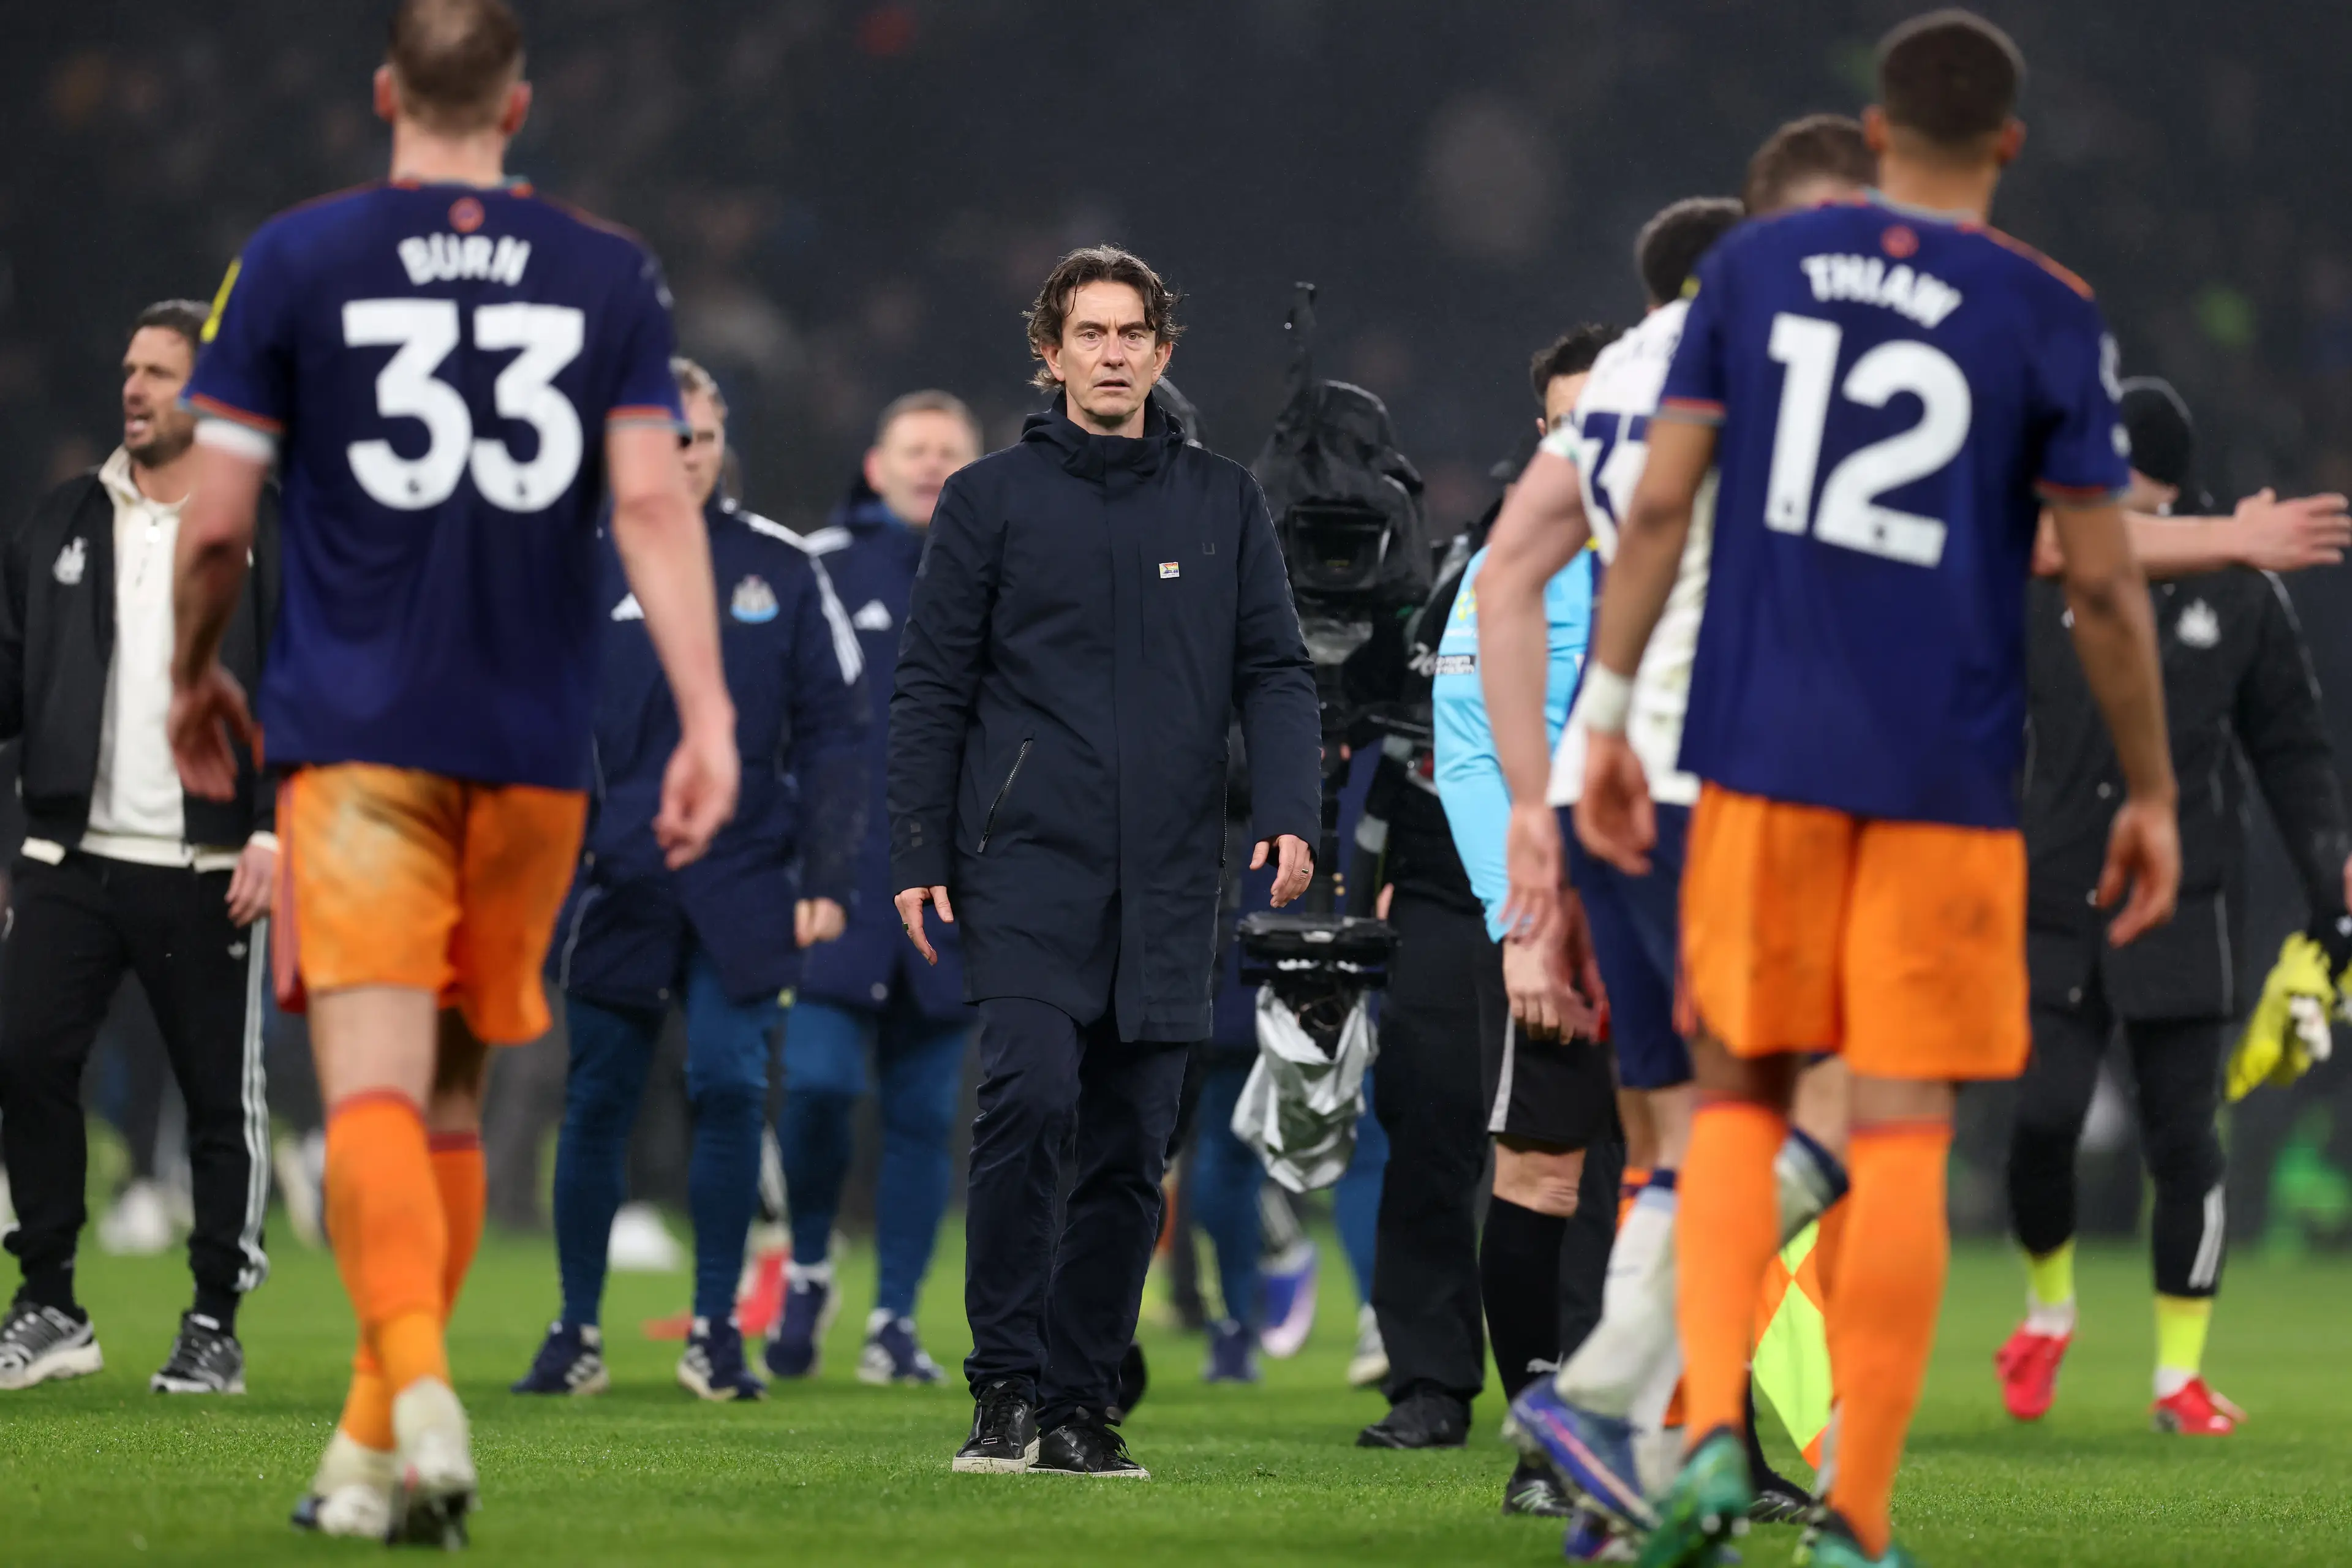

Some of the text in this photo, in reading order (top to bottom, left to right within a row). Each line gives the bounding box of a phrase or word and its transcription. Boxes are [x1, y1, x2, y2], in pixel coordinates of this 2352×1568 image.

[399, 232, 530, 286] BURN
[1801, 254, 1961, 328] THIAW
[341, 298, 585, 511] 33
[1765, 312, 1971, 565] 12
